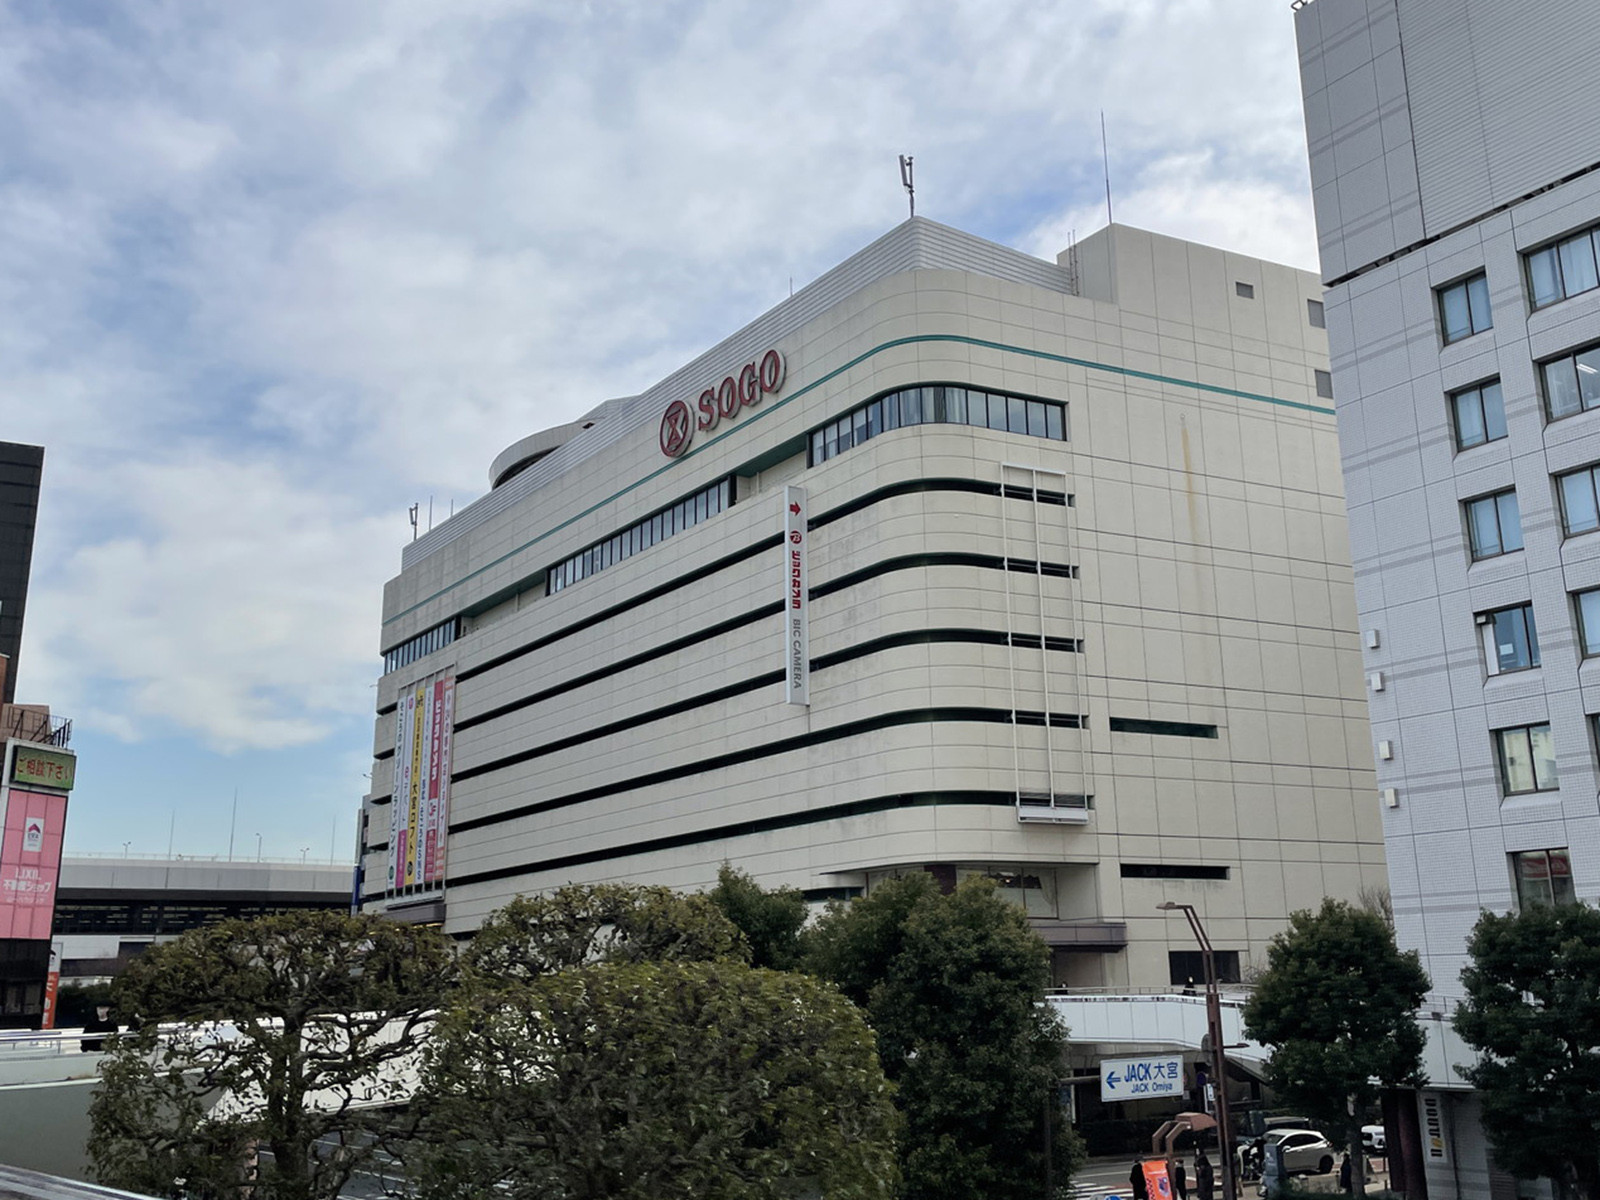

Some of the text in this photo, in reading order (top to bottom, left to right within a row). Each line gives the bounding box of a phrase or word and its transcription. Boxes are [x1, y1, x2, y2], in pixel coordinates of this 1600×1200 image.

[698, 349, 787, 432] SOGO
[792, 550, 801, 609] ビックカメラ
[793, 618, 802, 689] BIC CAMERA
[17, 757, 73, 781] ご相談下さい
[432, 700, 442, 780] ビックカメラ
[408, 782, 419, 856] 大宮ロフト
[1131, 1081, 1173, 1093] JACK Omiya
